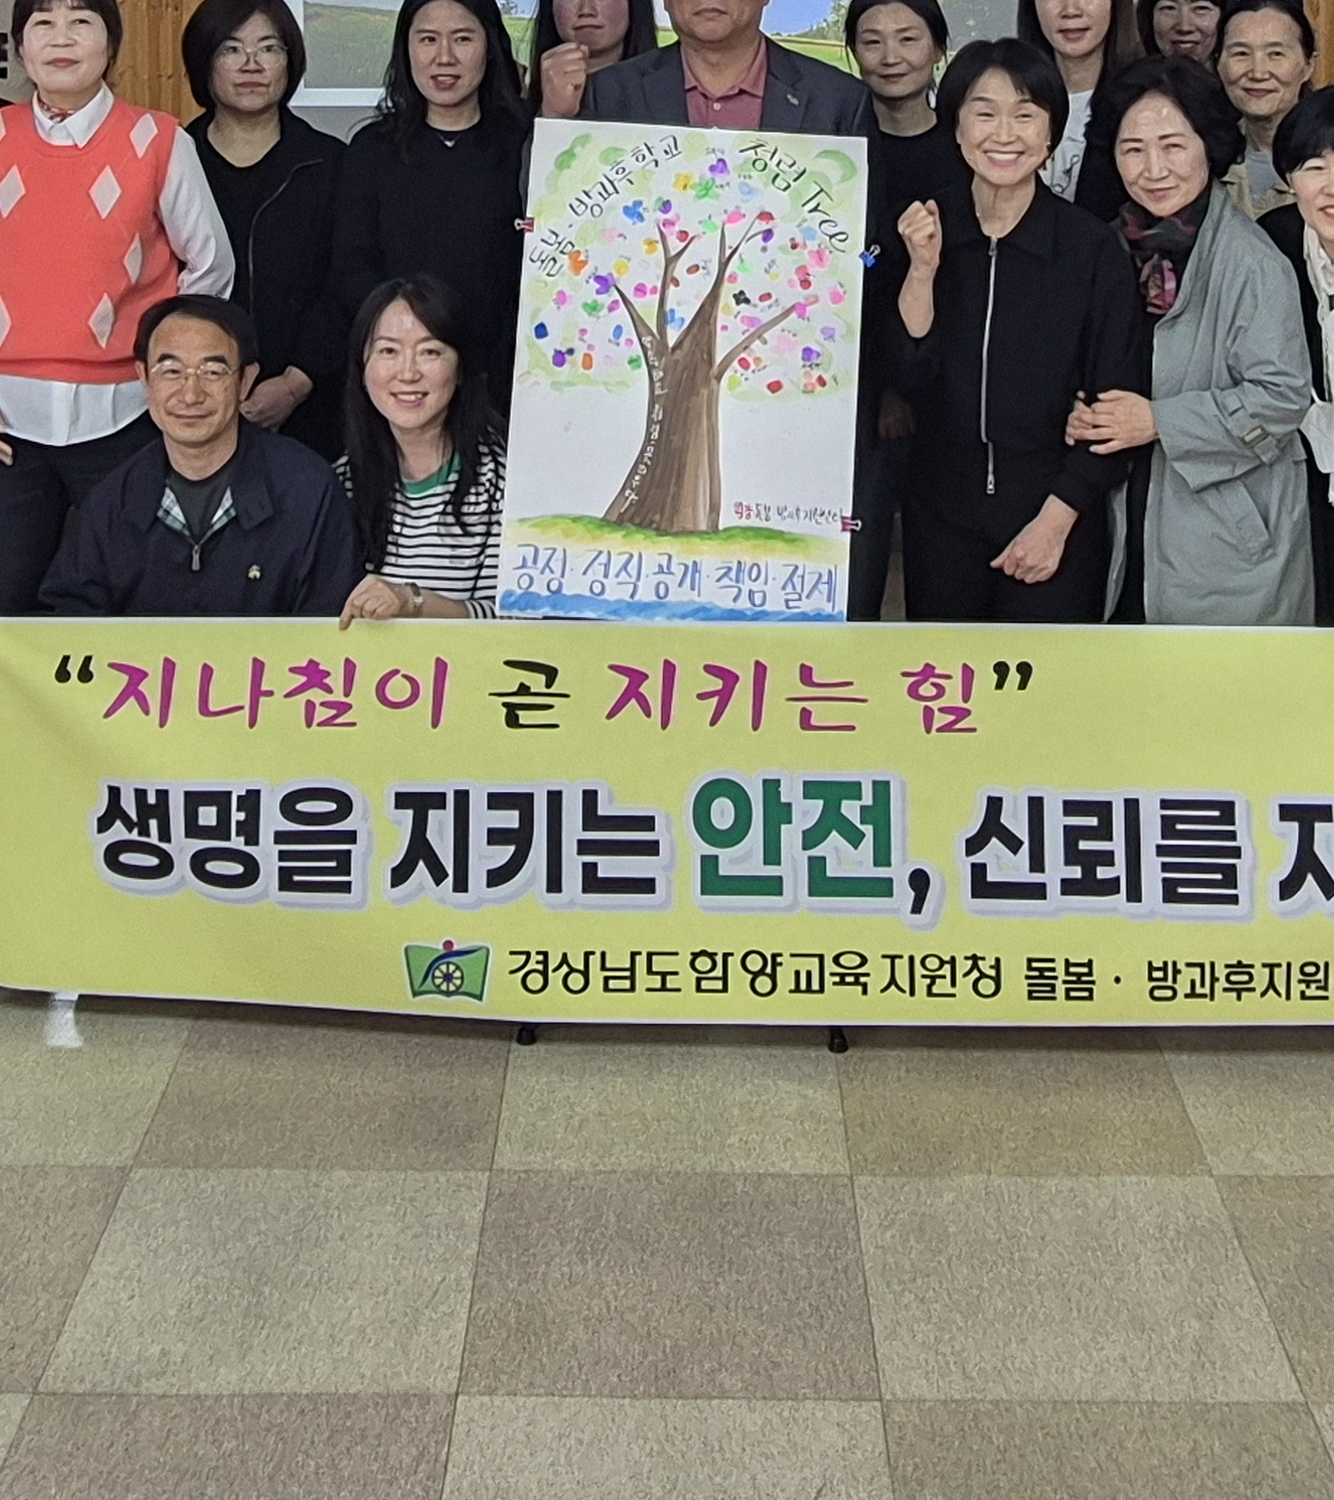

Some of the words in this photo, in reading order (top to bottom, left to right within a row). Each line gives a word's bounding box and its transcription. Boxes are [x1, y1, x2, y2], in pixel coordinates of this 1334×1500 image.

[568, 134, 682, 219] 방과후학교
[738, 138, 807, 193] 청렴
[801, 180, 850, 254] Tree
[53, 654, 450, 731] “지나침이
[488, 660, 572, 731] 곧
[604, 660, 869, 733] 지키는
[899, 660, 1034, 736] 힘”
[95, 783, 359, 896] 생명을
[389, 787, 660, 897] 지키는
[691, 777, 932, 917] 안전,
[963, 793, 1244, 907] 신뢰를
[507, 949, 1003, 1000] 경상남도함양교육지원청
